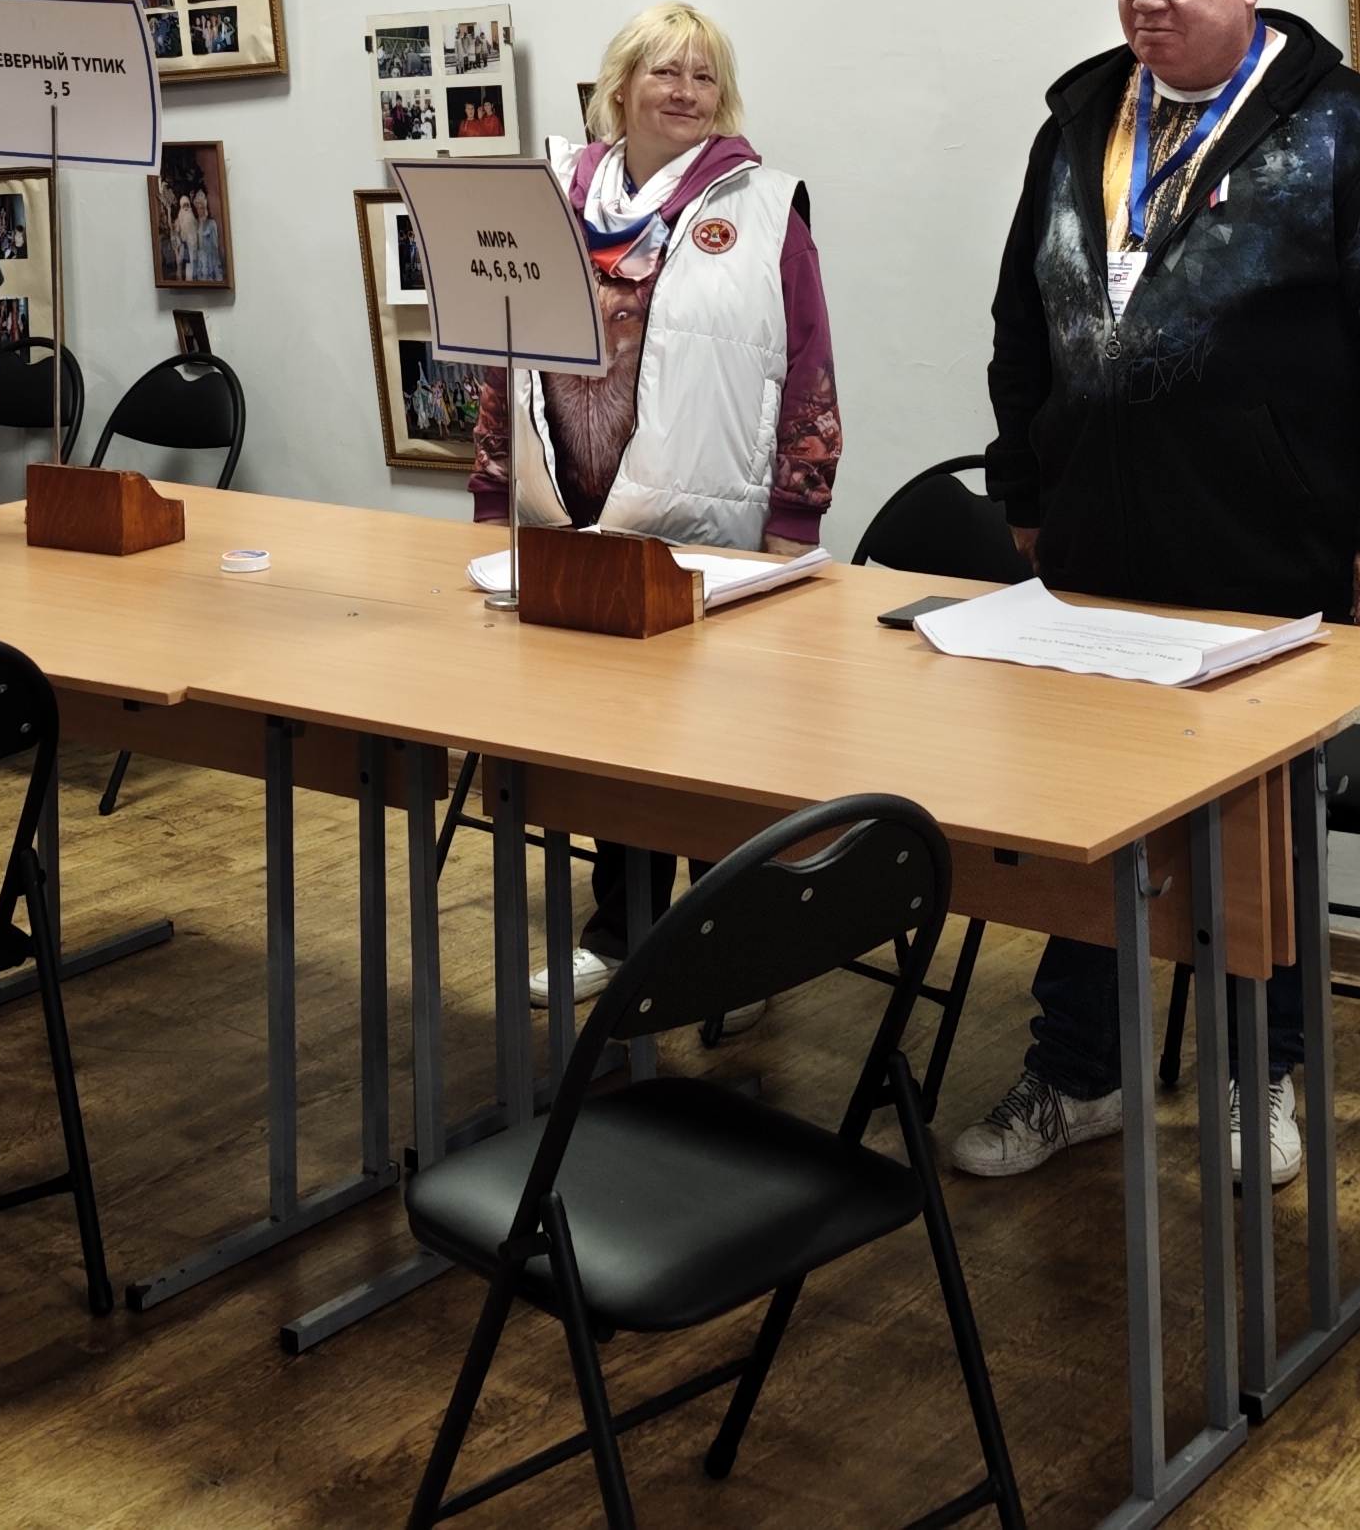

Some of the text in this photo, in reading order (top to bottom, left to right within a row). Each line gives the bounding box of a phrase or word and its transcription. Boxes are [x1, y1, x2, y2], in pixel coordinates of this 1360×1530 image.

[71, 56, 126, 74] ТУПИК
[44, 80, 71, 99] 3, 5
[476, 230, 518, 249] МИРА
[470, 258, 541, 283] 4А, 6, 8, 10
